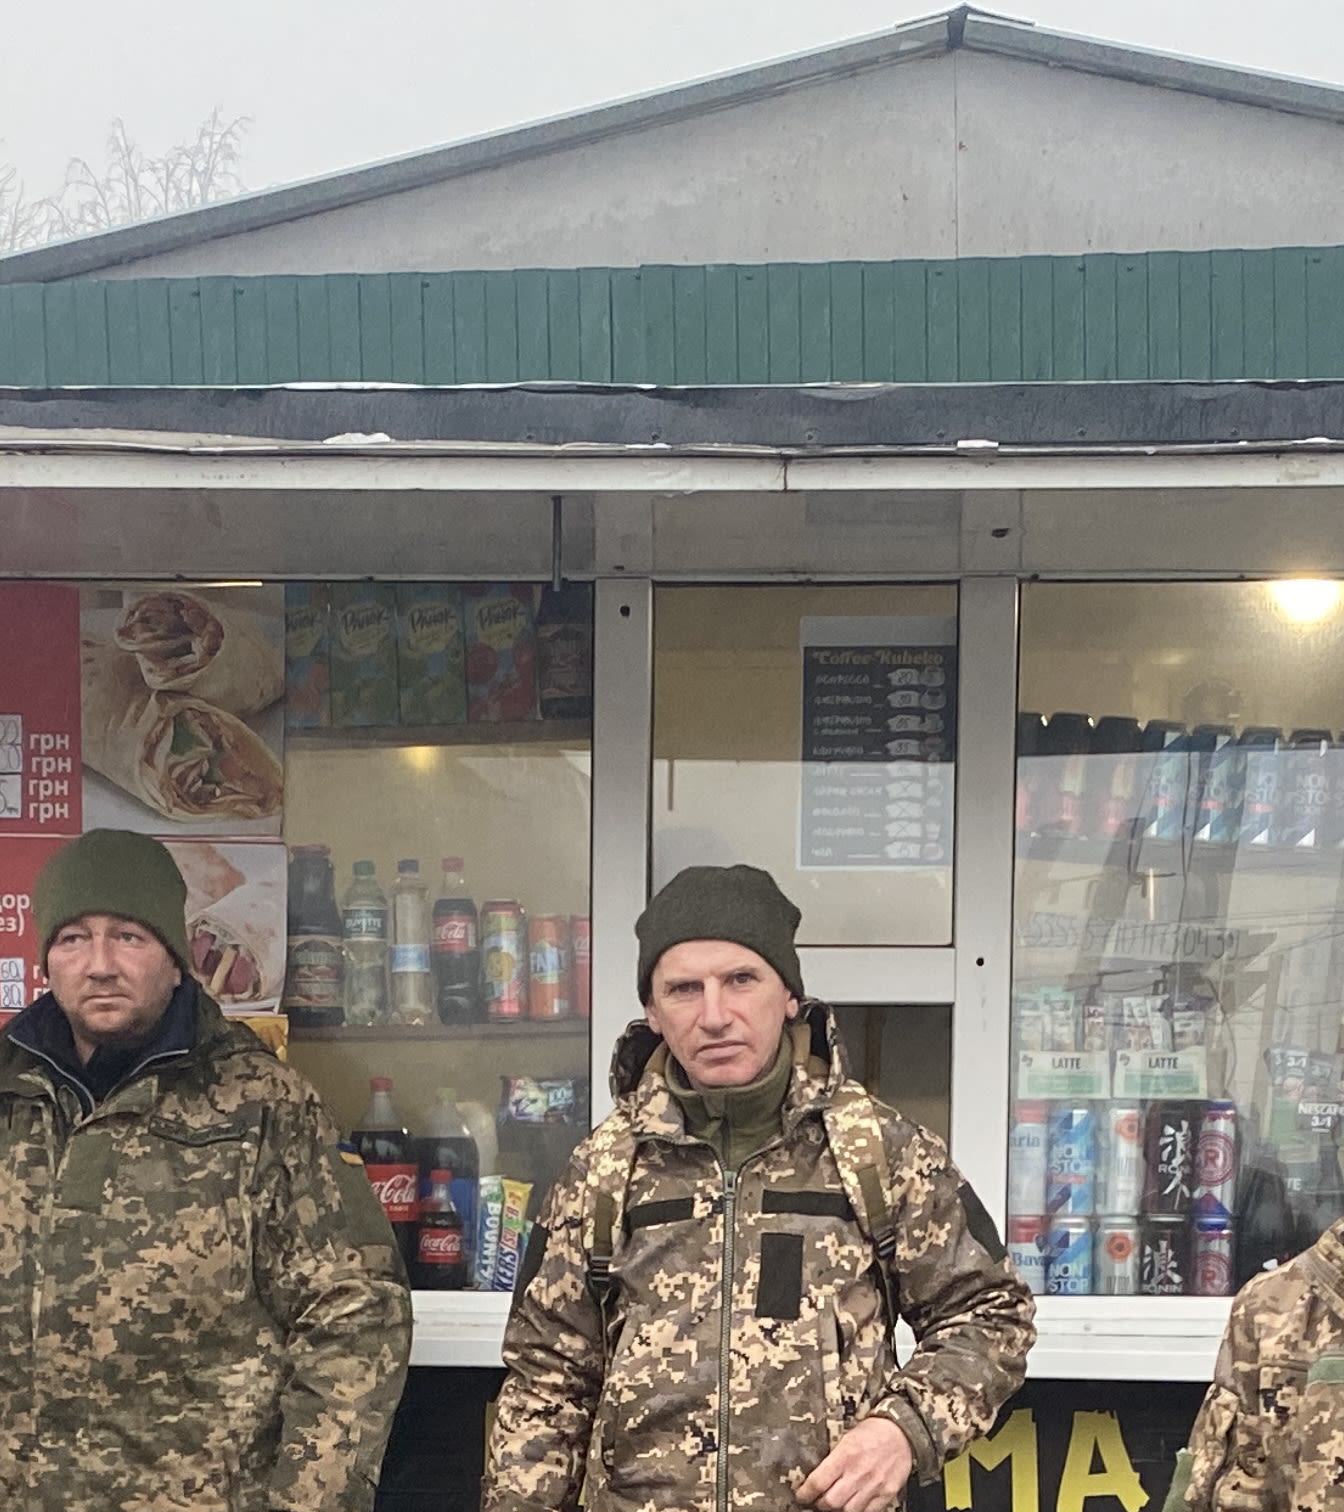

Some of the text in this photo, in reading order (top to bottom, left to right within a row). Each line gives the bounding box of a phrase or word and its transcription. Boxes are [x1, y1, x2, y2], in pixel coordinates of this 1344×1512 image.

[29, 733, 70, 755] грн
[31, 756, 72, 777] грн
[28, 779, 69, 800] грн
[28, 802, 69, 824] грн
[1052, 1057, 1081, 1070] LATTE
[1148, 1057, 1179, 1070] LATTE
[493, 1247, 517, 1292] KERS
[1049, 1263, 1083, 1278] NON
